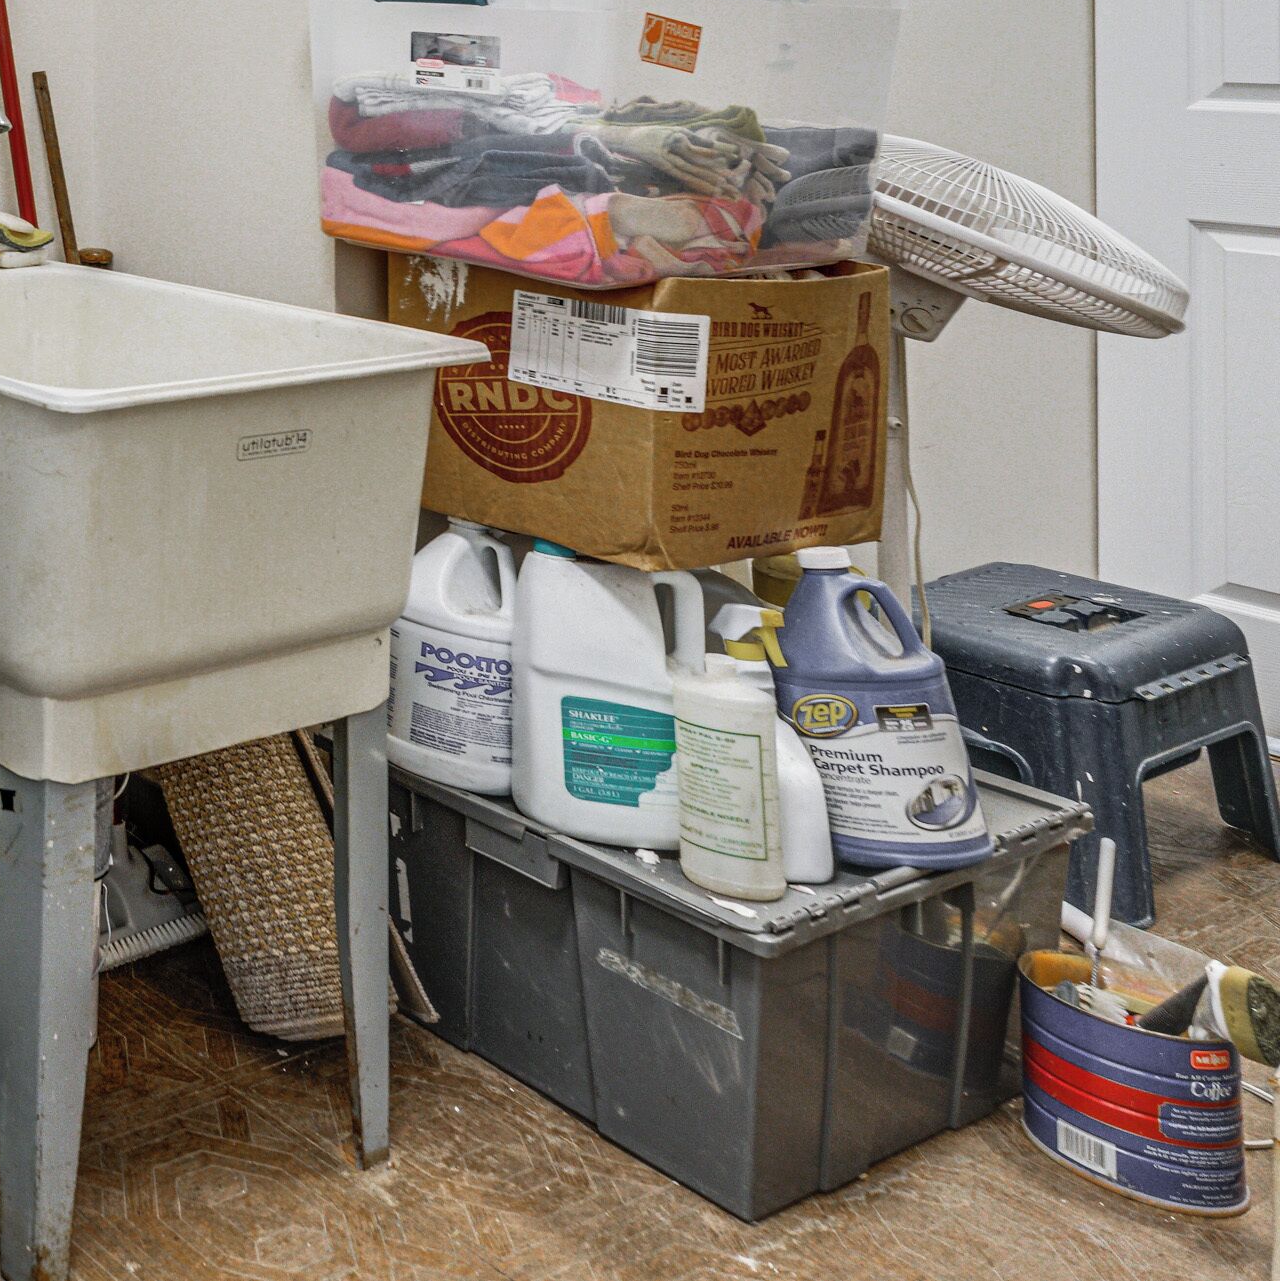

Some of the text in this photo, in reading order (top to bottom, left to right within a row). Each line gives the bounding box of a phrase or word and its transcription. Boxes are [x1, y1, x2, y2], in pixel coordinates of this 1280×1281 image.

[665, 21, 700, 41] FRAGILE
[712, 320, 804, 338] BIRD DOG WHISKEY
[715, 338, 822, 375] MOST AWARDED
[761, 360, 817, 391] WHISKEY
[447, 381, 574, 412] RNDC
[461, 421, 568, 460] DISTRIBUTING COMPANY
[674, 449, 691, 458] Bird
[693, 450, 709, 459] Dog
[711, 450, 748, 459] Chocolate
[672, 482, 691, 491] Shelf
[692, 482, 709, 490] Price
[726, 530, 792, 550] AVAILABLE
[427, 681, 461, 696] Swimming
[461, 689, 477, 699] Pool
[568, 710, 617, 723] SHAKLEE
[799, 701, 848, 732] zep
[570, 731, 610, 744] BASIC-G
[809, 744, 883, 763] Premium
[572, 772, 605, 783] DANGER
[813, 757, 945, 780] Carpet Shampoo
[821, 773, 872, 786] oncentrate
[1191, 1080, 1233, 1101] Coffee
